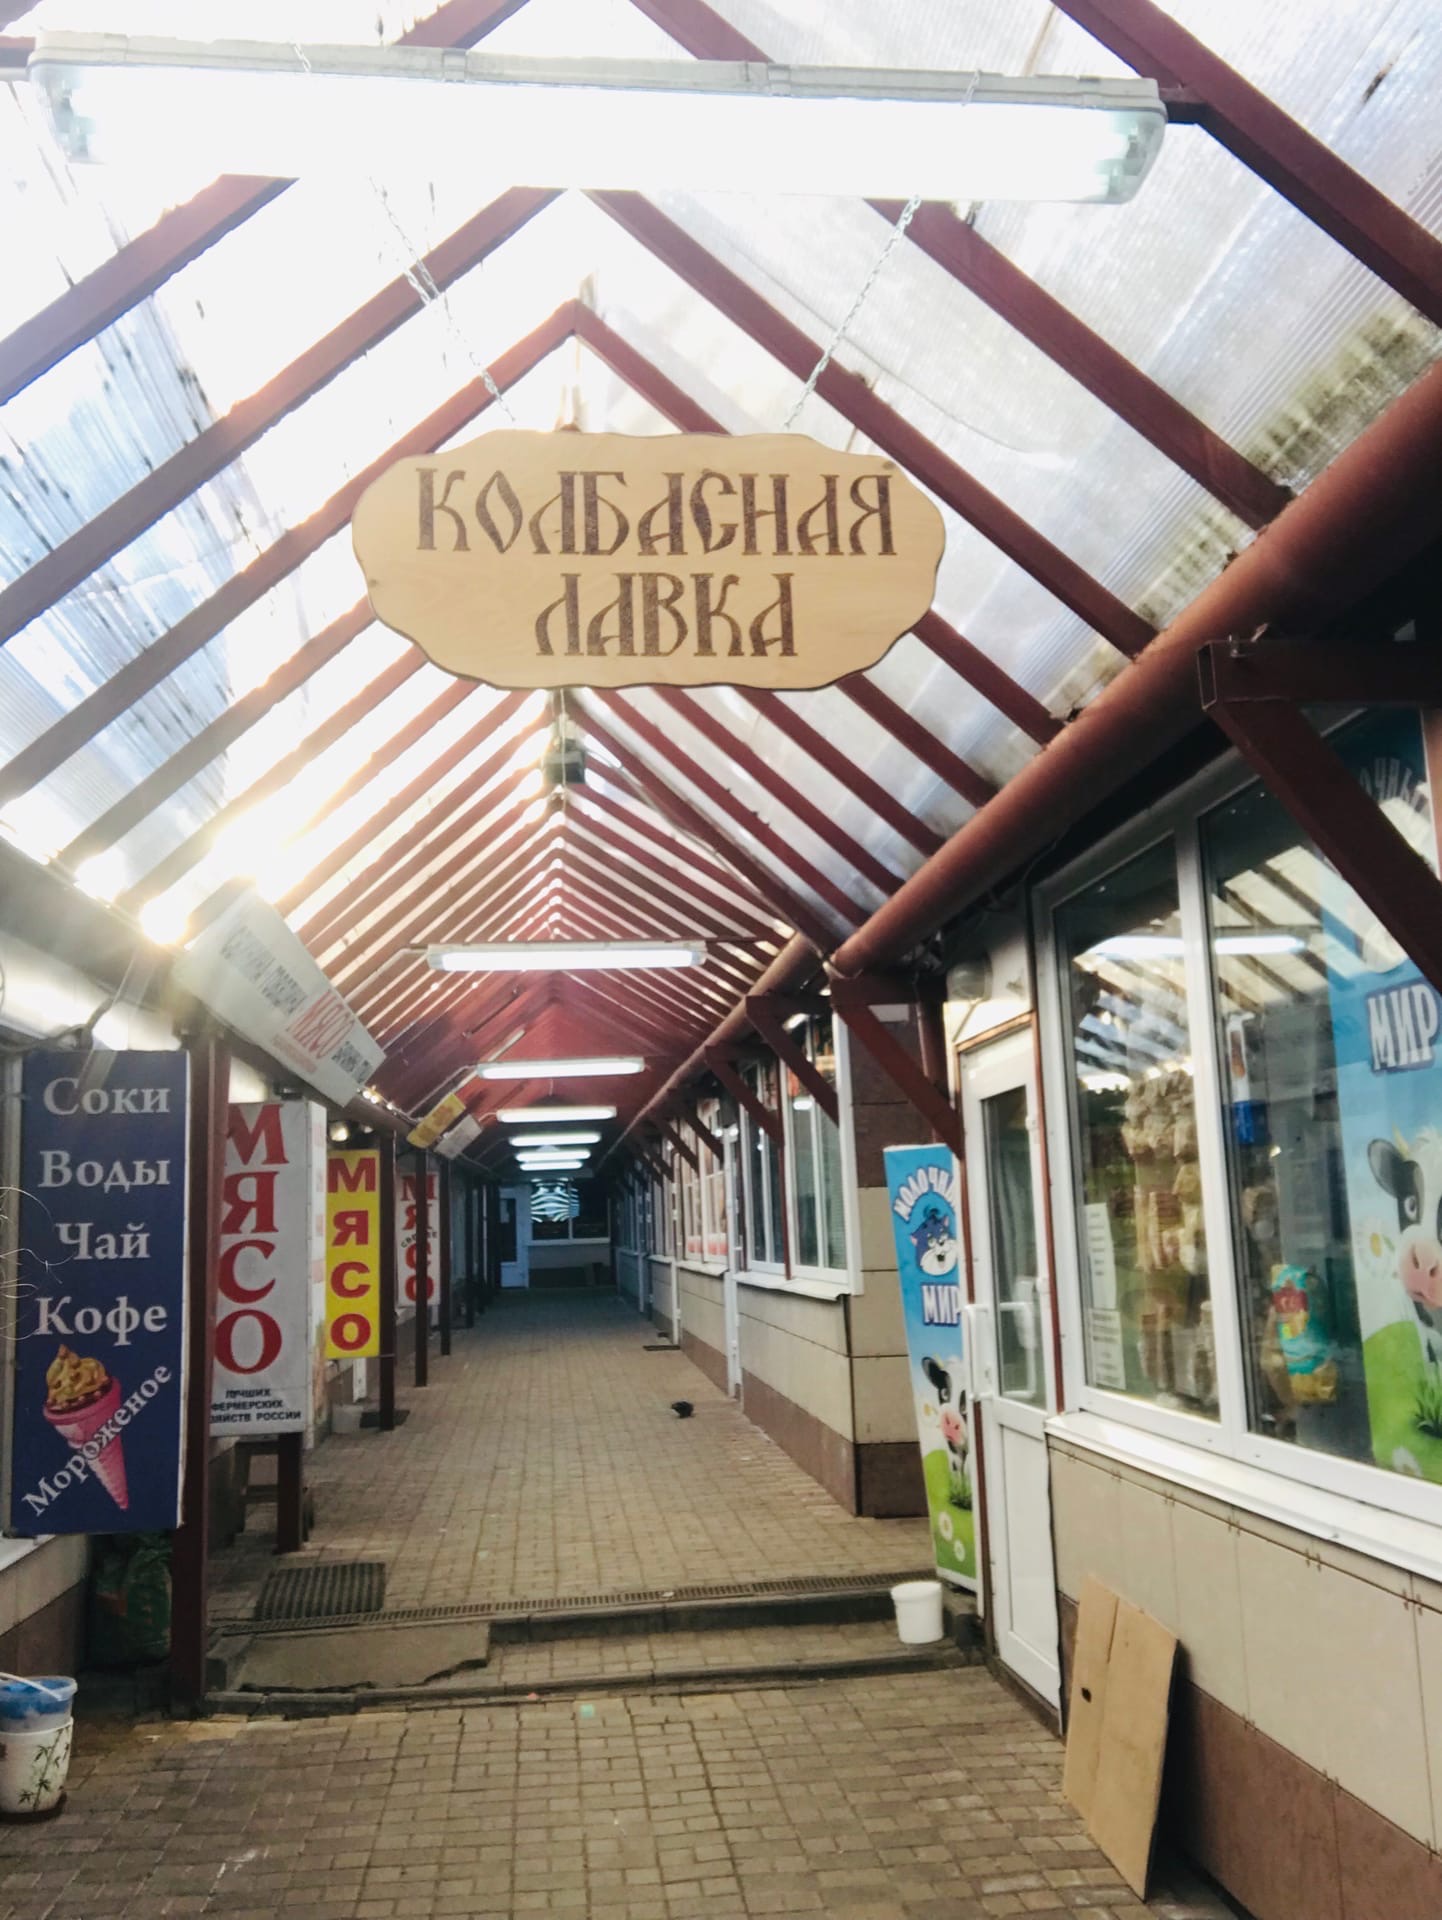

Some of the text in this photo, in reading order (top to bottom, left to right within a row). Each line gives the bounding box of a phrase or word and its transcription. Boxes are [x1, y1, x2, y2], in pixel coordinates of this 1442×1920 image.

[415, 466, 898, 556] КОЛБАСНАЯ
[534, 571, 799, 657] ЛАВКА
[1367, 983, 1439, 1070] МИР
[42, 1075, 171, 1117] Соки
[38, 1149, 170, 1192] Воды
[55, 1220, 151, 1261] Чай
[214, 1103, 289, 1375] МЯСО
[328, 1157, 376, 1351] МЯСО
[34, 1296, 168, 1347] Кофе
[21, 1364, 173, 1517] Мороженое
